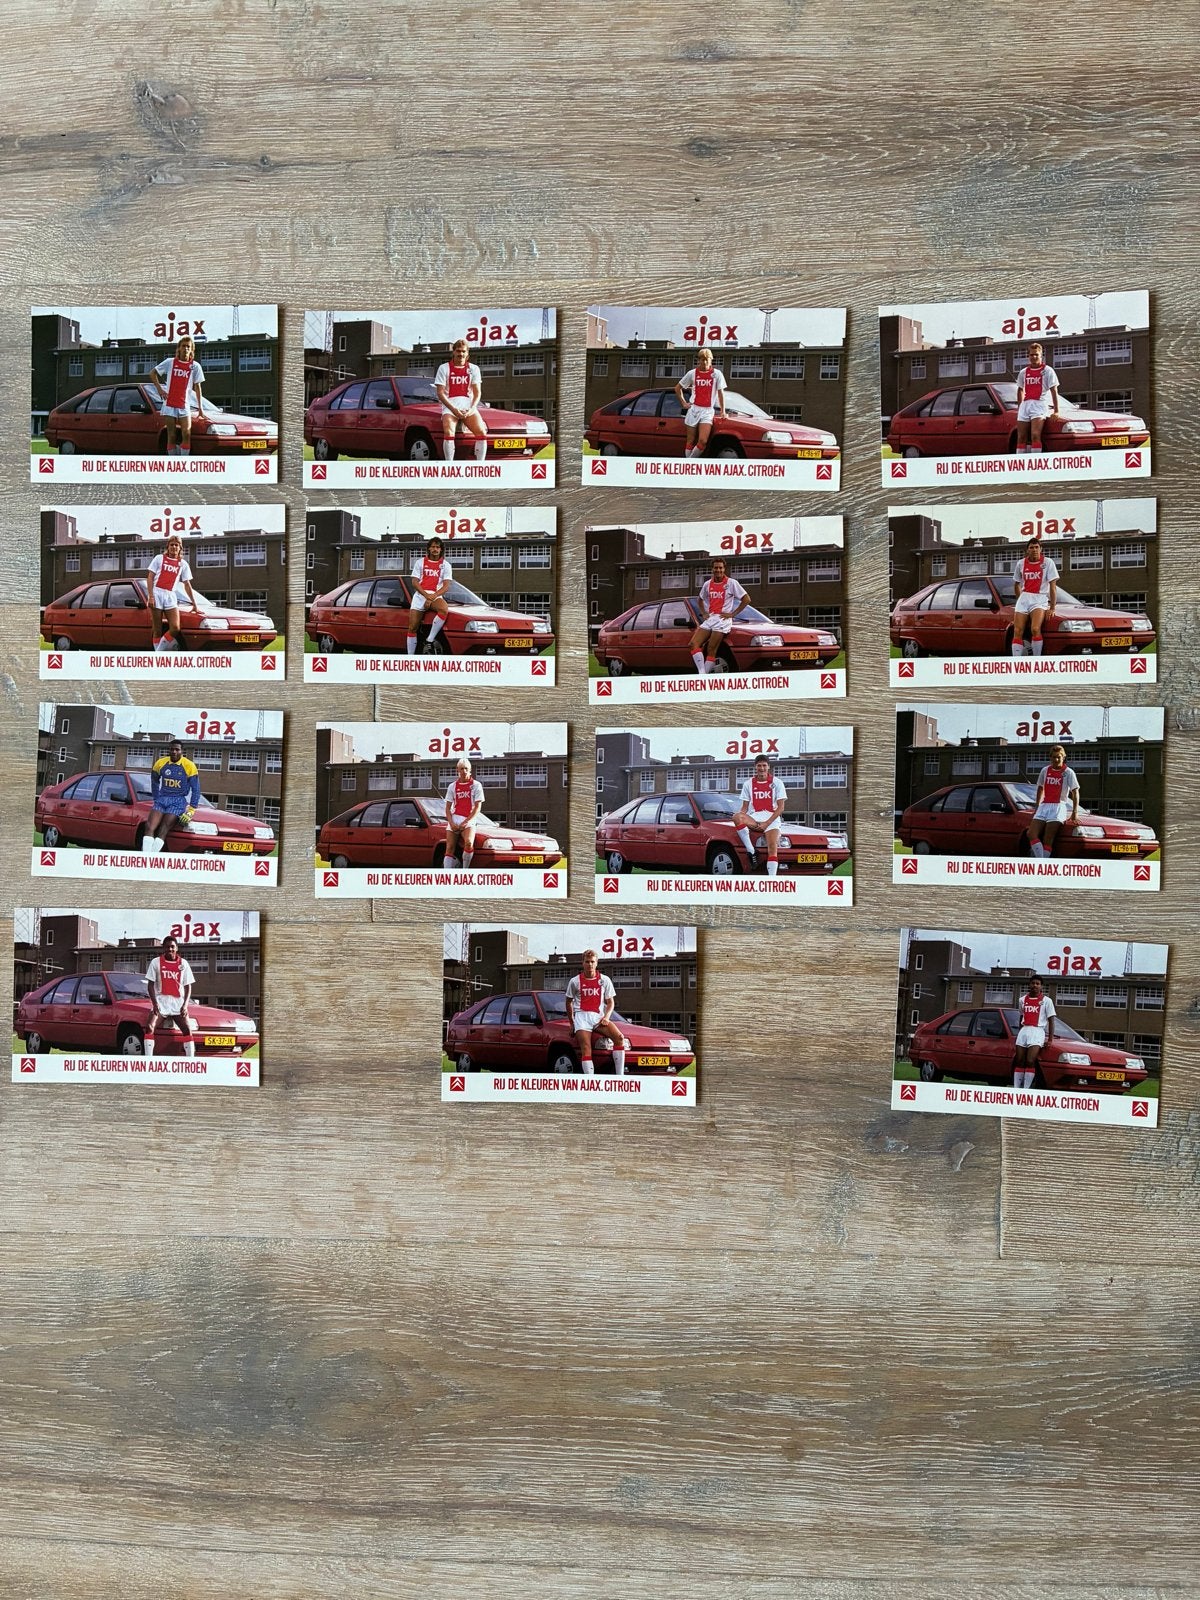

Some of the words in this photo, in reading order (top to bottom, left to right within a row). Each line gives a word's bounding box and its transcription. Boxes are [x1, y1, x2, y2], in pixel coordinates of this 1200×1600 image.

[153, 312, 205, 342] ajax
[1002, 307, 1058, 338] ajax
[466, 317, 518, 347] ajax
[683, 315, 738, 346] ajax
[173, 368, 189, 378] TDK
[451, 376, 468, 385] TDK
[696, 379, 712, 387] TDK
[1026, 377, 1041, 385] TDK
[82, 461, 94, 471] RIJ
[97, 461, 107, 472] DE
[109, 461, 146, 472] KLEUREN
[149, 461, 164, 472] VAN
[355, 467, 367, 477] RIJ
[370, 466, 380, 477] DE
[382, 466, 420, 477] KLEUREN
[422, 466, 439, 477] VAN
[636, 463, 647, 474] RIJ
[650, 463, 661, 474] DE
[663, 463, 702, 475] KLEUREN
[704, 464, 721, 475] VAN
[936, 463, 948, 474] RIJ
[952, 462, 963, 473] DE
[965, 460, 1005, 473] KLEUREN
[1007, 459, 1025, 471] VAN
[150, 508, 201, 537] ajax
[435, 509, 486, 539] ajax
[1020, 510, 1075, 539] ajax
[720, 525, 773, 555] ajax
[163, 564, 178, 573] TDK
[424, 569, 439, 577] TDK
[1024, 571, 1041, 580] TDK
[709, 591, 723, 599] TDK
[90, 656, 102, 667] RIJ
[104, 656, 115, 667] DE
[116, 657, 153, 667] KLEUREN
[156, 657, 171, 667] VAN
[356, 660, 367, 670] RIJ
[370, 660, 381, 671] DE
[383, 660, 421, 671] KLEUREN
[423, 660, 439, 671] VAN
[944, 663, 956, 674] RIJ
[959, 663, 970, 674] DE
[972, 662, 1012, 674] KLEUREN
[1015, 662, 1032, 673] VAN
[640, 682, 652, 693] RIJ
[655, 681, 666, 692] DE
[668, 680, 706, 692] KLEUREN
[709, 679, 725, 690] VAN
[185, 711, 236, 740] ajax
[1016, 711, 1072, 741] ajax
[428, 728, 480, 757] ajax
[726, 731, 779, 759] ajax
[164, 778, 181, 788] TDK
[1047, 777, 1061, 785] TDK
[754, 791, 771, 799] TDK
[84, 855, 95, 865] RIJ
[98, 855, 108, 866] DE
[110, 856, 148, 867] KLEUREN
[150, 857, 165, 868] VAN
[947, 861, 959, 873] RIJ
[962, 862, 973, 873] DE
[976, 862, 1016, 874] KLEUREN
[1018, 863, 1035, 875] VAN
[367, 874, 379, 885] RIJ
[382, 874, 392, 885] DE
[394, 874, 432, 885] KLEUREN
[435, 874, 451, 885] VAN
[647, 880, 659, 891] RIJ
[662, 880, 673, 891] DE
[675, 880, 713, 891] KLEUREN
[716, 880, 732, 891] VAN
[170, 914, 220, 943] ajax
[602, 928, 654, 958] ajax
[1047, 946, 1102, 976] ajax
[582, 988, 600, 997] TDK
[1025, 1005, 1039, 1013] TDK
[64, 1060, 75, 1071] RIJ
[78, 1060, 89, 1071] DE
[91, 1060, 128, 1071] KLEUREN
[130, 1061, 146, 1072] VAN
[494, 1078, 505, 1090] RIJ
[508, 1078, 519, 1090] DE
[521, 1079, 559, 1090] KLEUREN
[561, 1079, 578, 1090] VAN
[946, 1089, 958, 1101] RIJ
[960, 1090, 972, 1102] DE
[974, 1091, 1014, 1104] KLEUREN
[1016, 1094, 1034, 1106] VAN
